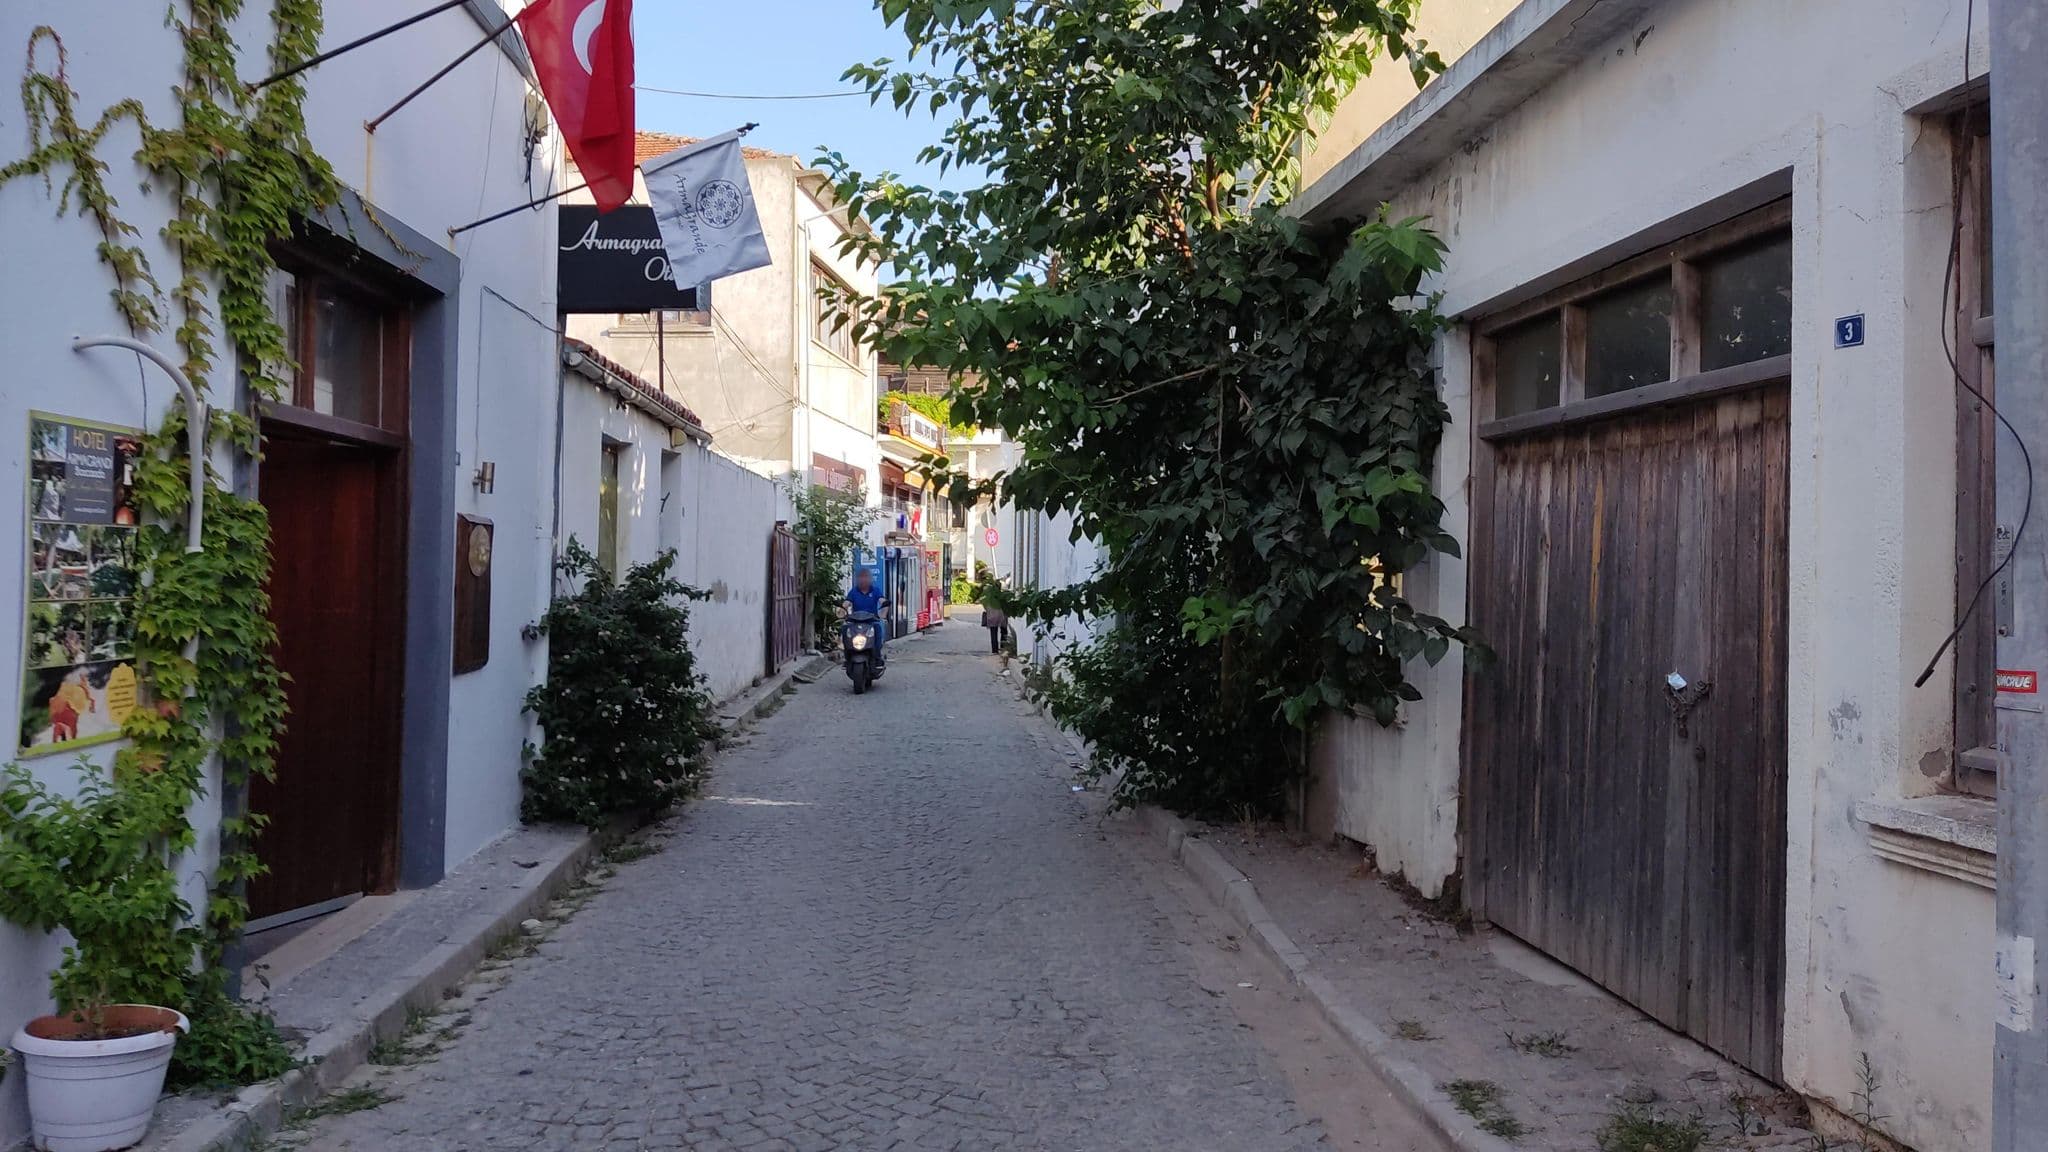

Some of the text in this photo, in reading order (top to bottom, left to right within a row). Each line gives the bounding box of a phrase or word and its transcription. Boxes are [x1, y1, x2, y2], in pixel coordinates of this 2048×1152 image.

[560, 219, 666, 255] Armagra
[1844, 322, 1853, 341] 3
[74, 430, 106, 451] HOTEL
